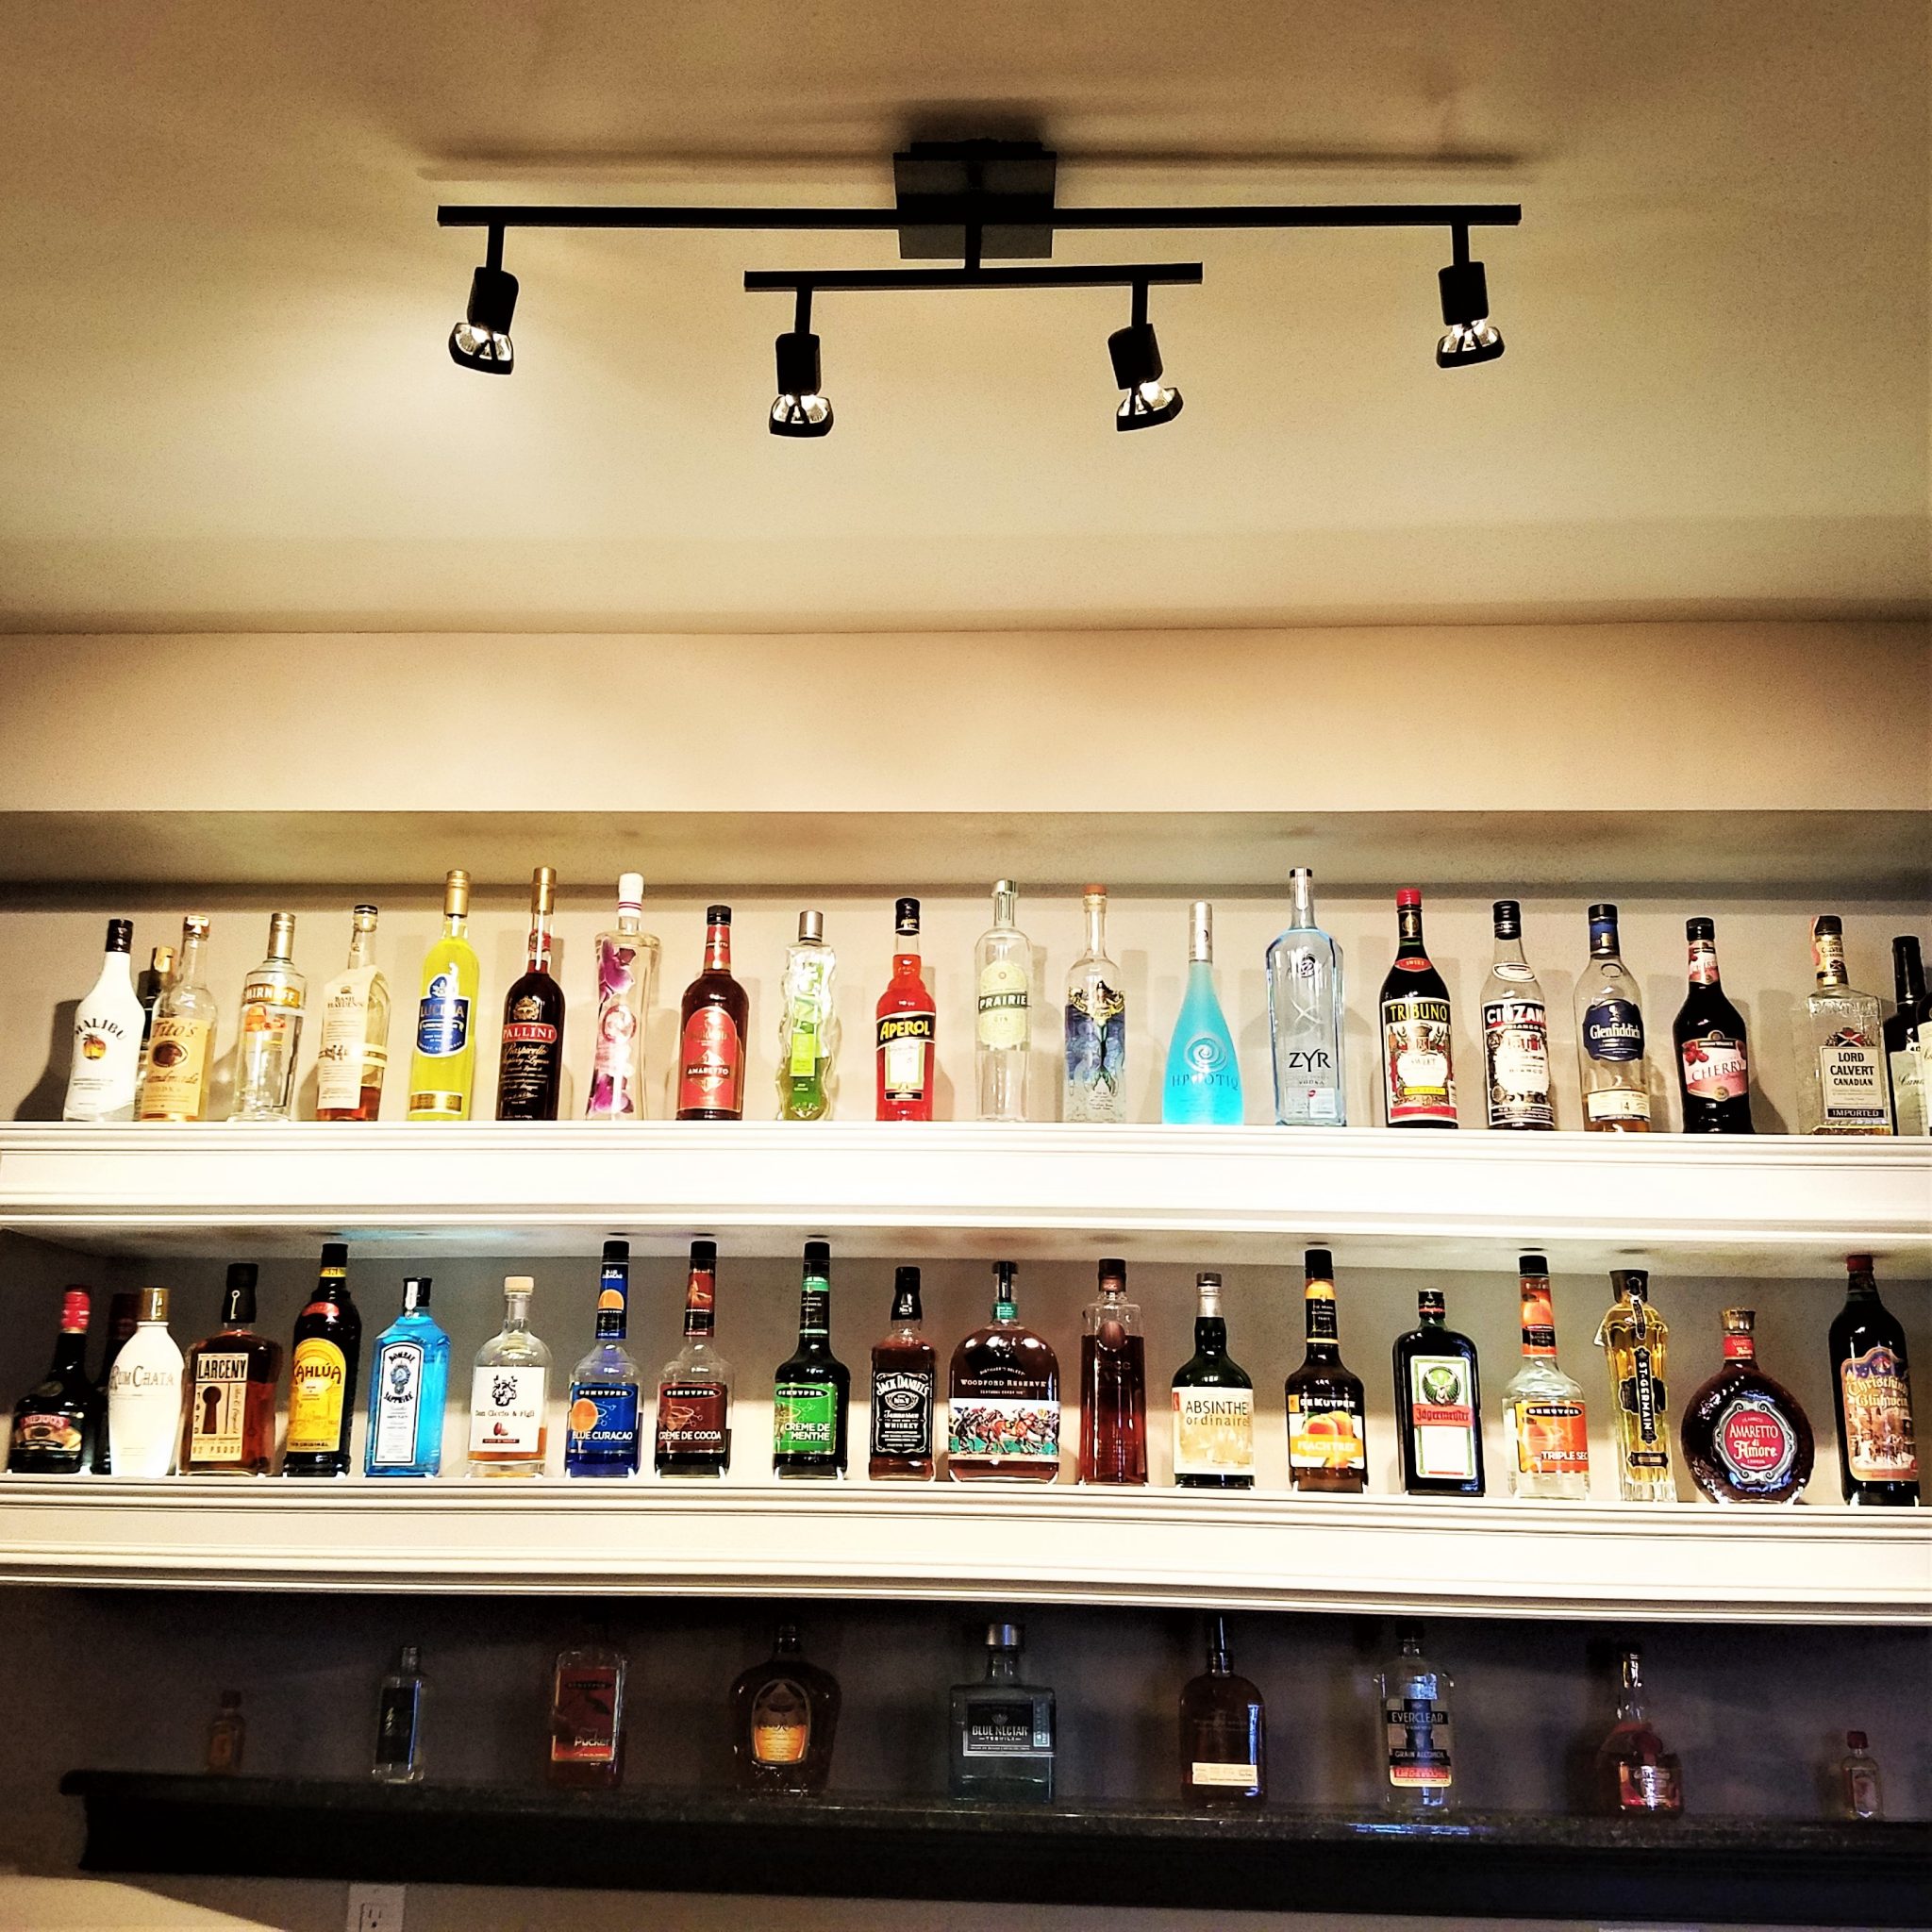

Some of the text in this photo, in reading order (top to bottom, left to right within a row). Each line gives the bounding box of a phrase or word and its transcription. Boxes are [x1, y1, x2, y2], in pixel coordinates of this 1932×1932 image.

[978, 994, 1027, 1009] PRAIRIE
[1390, 1003, 1448, 1022] TRIBUNO
[75, 1018, 126, 1041] MALIBU
[152, 1020, 199, 1038] Tito's
[503, 1026, 554, 1040] PALLINI
[879, 1020, 931, 1041] APEROL
[1590, 1022, 1641, 1040] Glenfiddich
[1288, 1048, 1332, 1073] ZYR
[1838, 1052, 1865, 1062] LORD
[1691, 1059, 1743, 1082] CHERRY
[1830, 1065, 1874, 1075] CALVERT
[1833, 1077, 1874, 1086] CANADIAN
[1833, 1109, 1879, 1118] IMPORTED
[197, 1359, 247, 1379] LARCENY
[875, 1377, 897, 1396] JACK
[959, 1378, 1005, 1387] WOODFORD
[1185, 1400, 1248, 1416] ABSINTHE
[817, 1423, 831, 1432] DE
[1186, 1415, 1250, 1427] ordinaire
[591, 1430, 633, 1441] CURACAO
[681, 1430, 693, 1441] DE
[693, 1430, 722, 1441] COCOA
[791, 1431, 830, 1441] MENTHE
[1729, 1423, 1778, 1439] AMARETTO
[1751, 1438, 1760, 1447] di
[1541, 1450, 1575, 1460] TRIPLE
[1733, 1440, 1778, 1460] Amore
[1391, 1711, 1444, 1724] EVERCLEAR
[972, 1725, 1028, 1737] BLUE NECTAR
[1394, 1750, 1415, 1758] GRAIN
